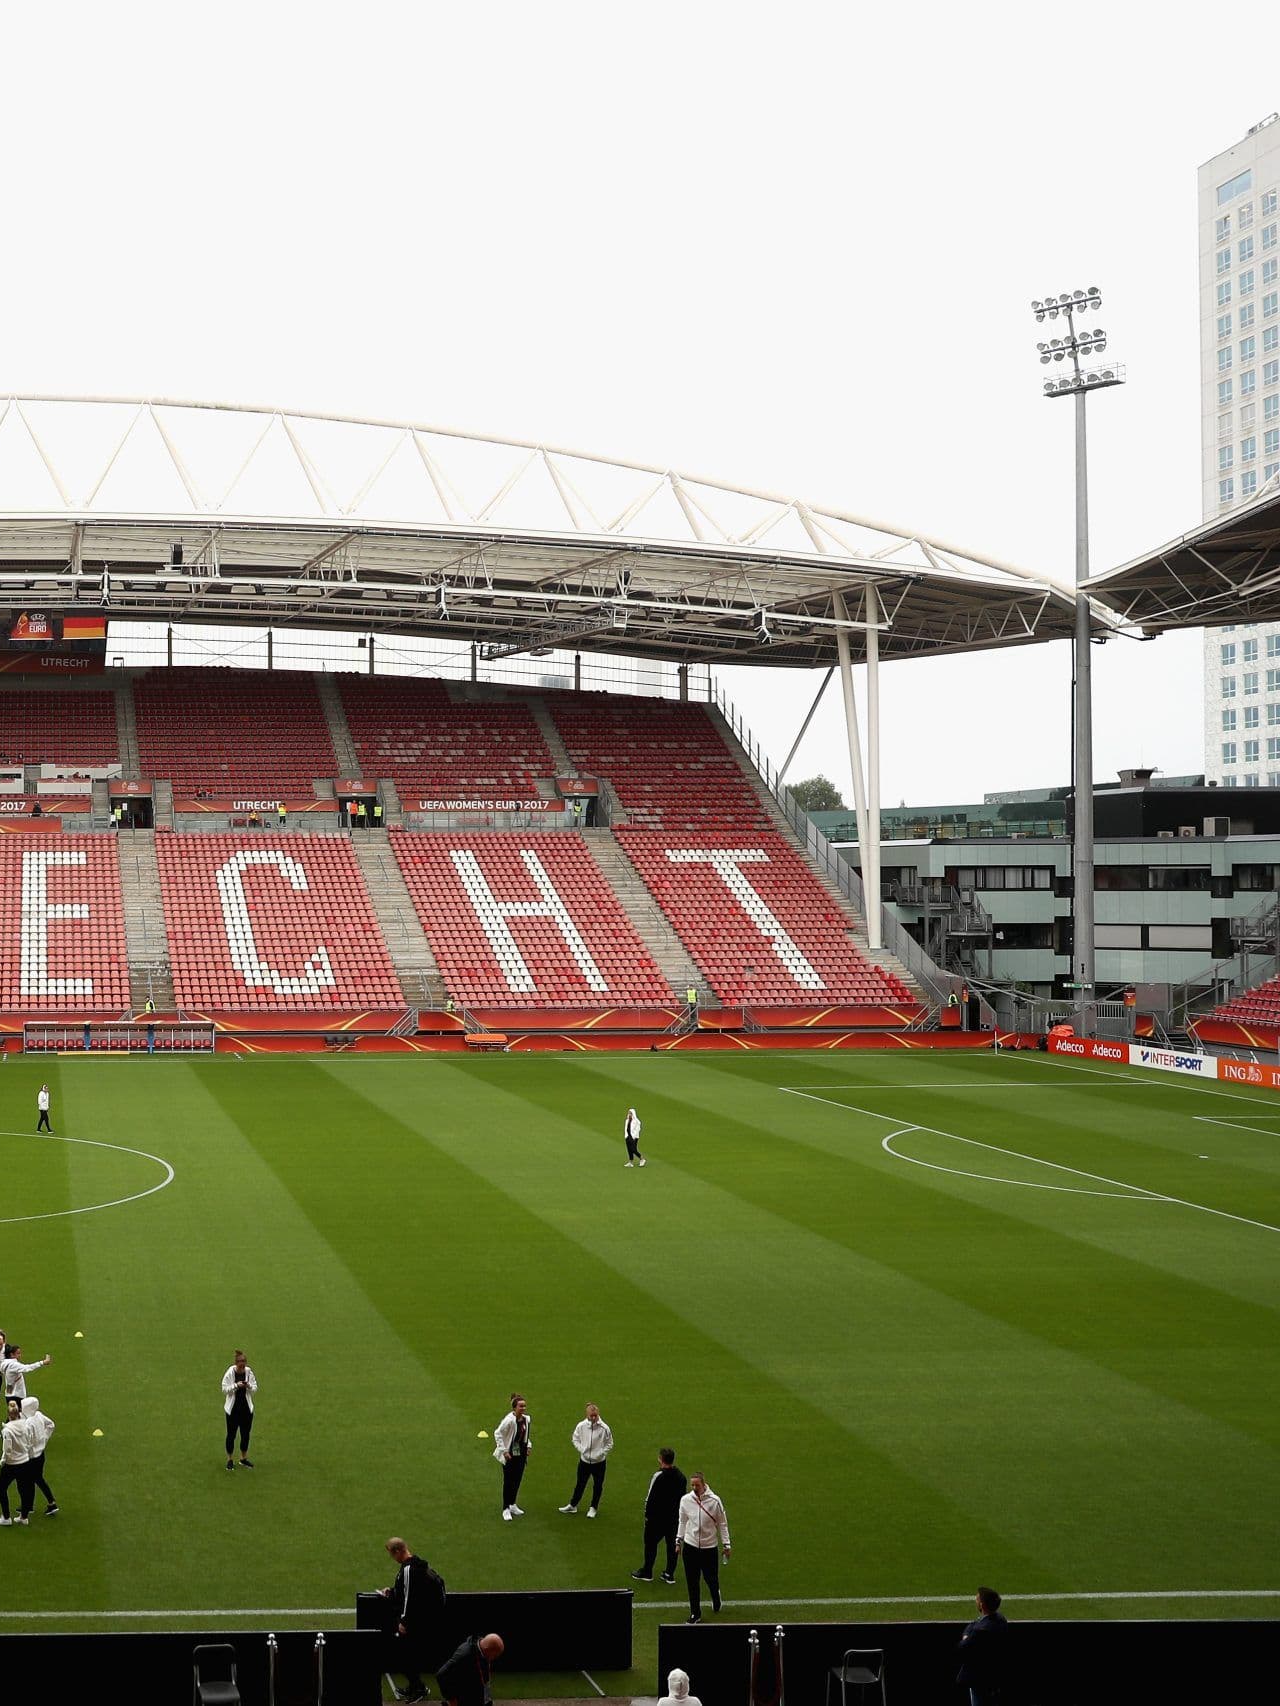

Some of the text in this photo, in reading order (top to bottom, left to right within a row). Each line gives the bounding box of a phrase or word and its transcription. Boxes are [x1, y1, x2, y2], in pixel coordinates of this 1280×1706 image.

[29, 625, 47, 633] EURO
[41, 657, 90, 668] UTRECHT
[0, 801, 26, 811] 2017
[233, 801, 282, 810] UTRECHT
[419, 801, 446, 810] UEFA
[446, 801, 494, 810] WOMEN'S
[524, 801, 550, 810] 2017
[1056, 1039, 1121, 1059] Adecco Adecco
[1150, 1052, 1203, 1071] INTERSPORT
[1224, 1065, 1246, 1080] ING
